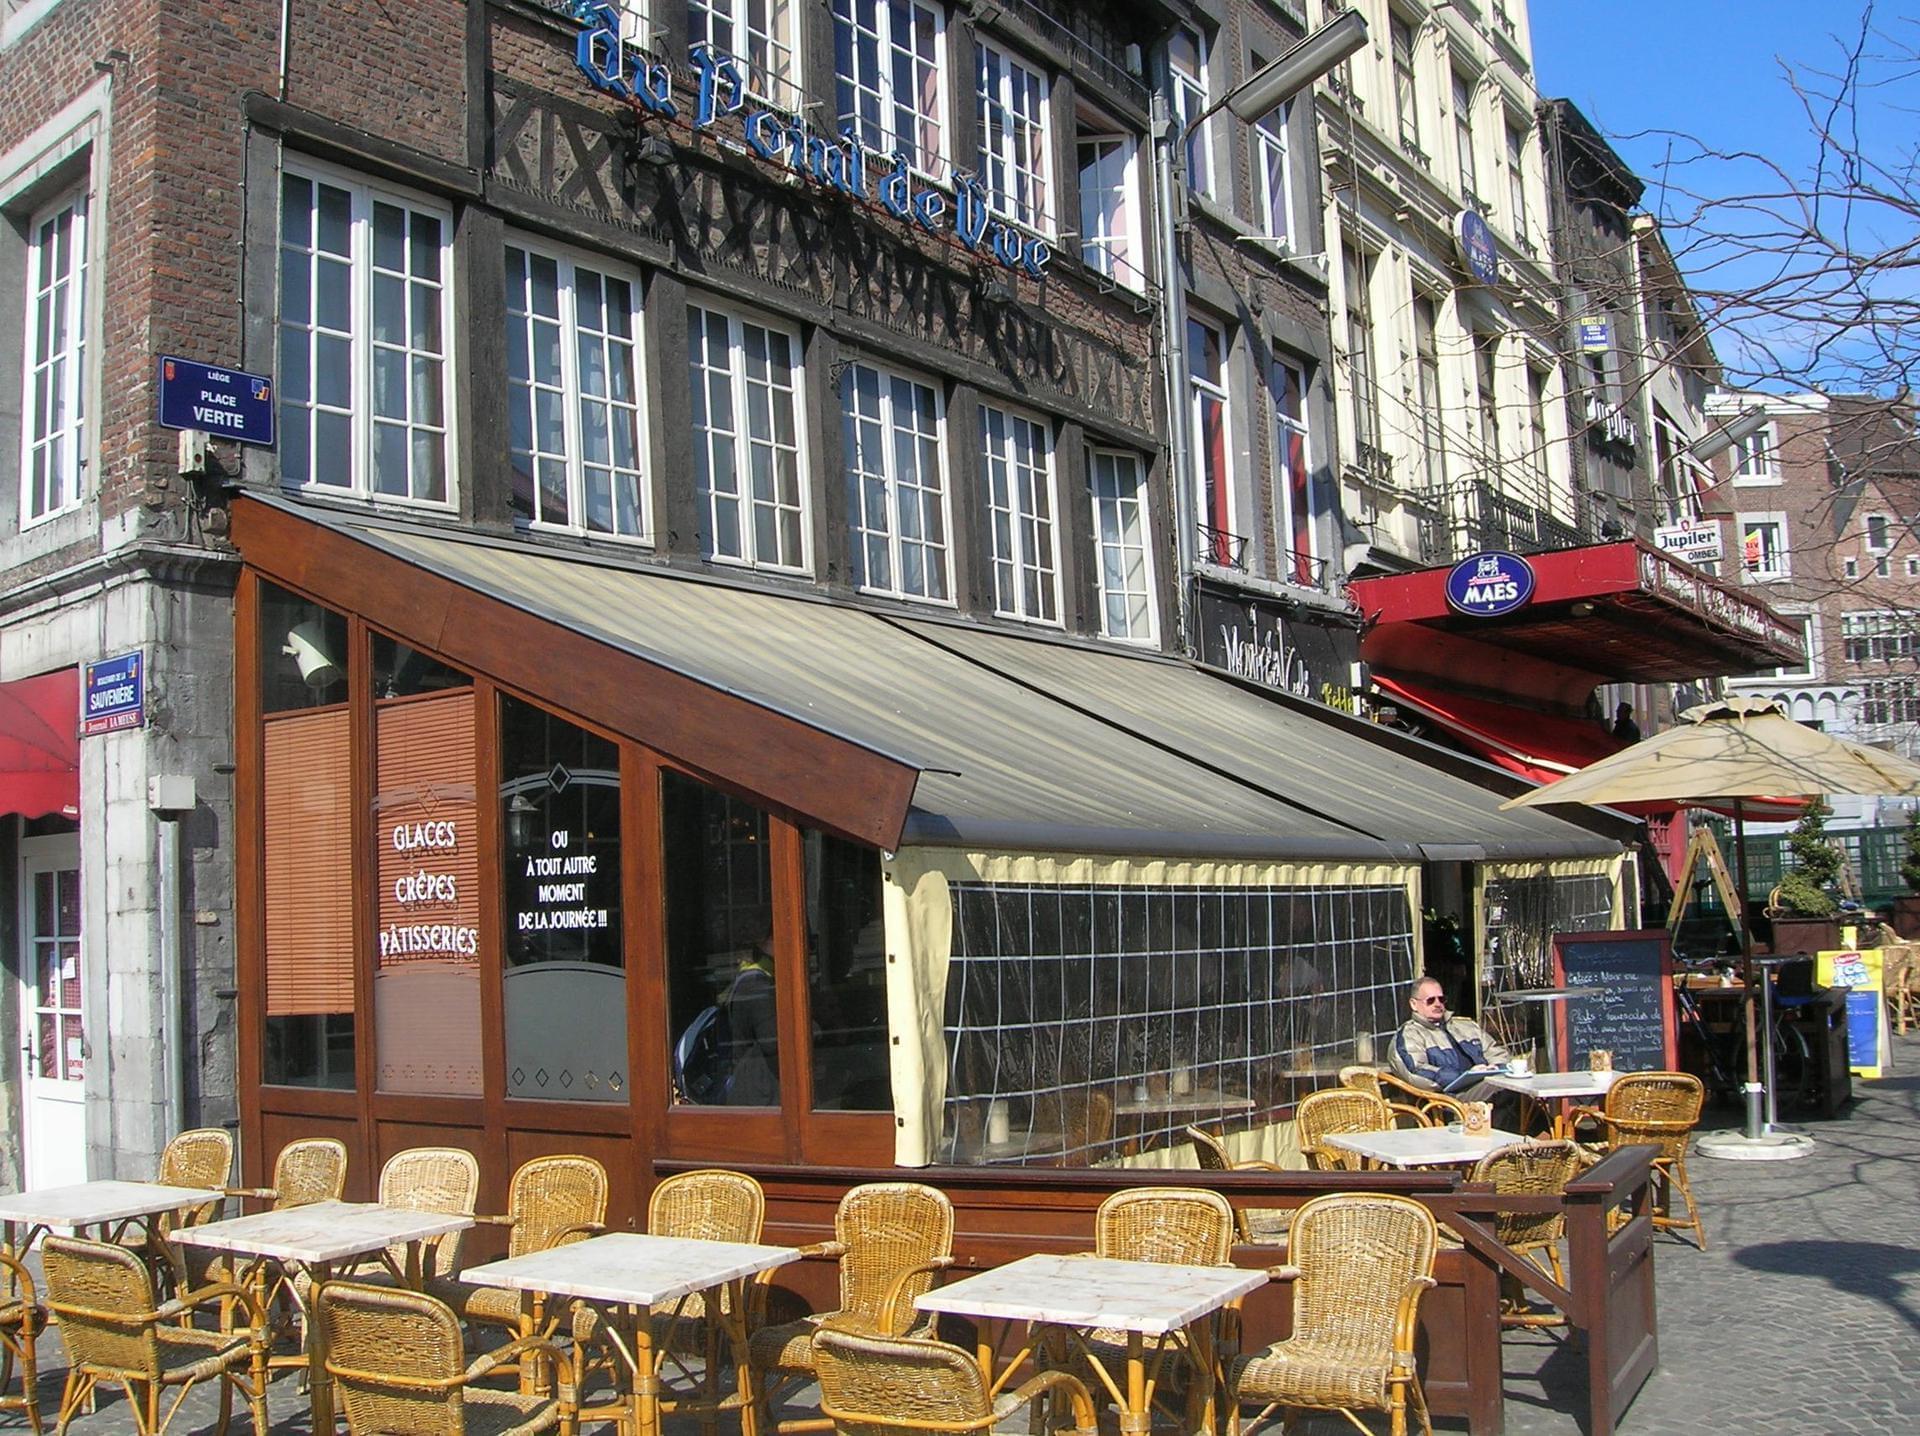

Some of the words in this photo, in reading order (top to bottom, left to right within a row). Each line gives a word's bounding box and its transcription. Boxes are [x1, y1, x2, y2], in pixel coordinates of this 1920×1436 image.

[692, 48, 870, 200] Point
[879, 151, 945, 233] de
[207, 371, 231, 383] LIÈGE
[201, 390, 237, 407] PLACE
[193, 405, 244, 429] VERTE
[1660, 531, 1716, 549] Jupiler
[1462, 582, 1518, 604] MAES
[90, 683, 135, 711] SAUVENIÈRE
[393, 821, 456, 850] GLACES
[552, 830, 569, 849] OU
[526, 855, 535, 877] À
[535, 857, 563, 876] TOUT
[563, 855, 597, 875] AUTRE
[395, 868, 456, 902] CRÊPES
[538, 883, 585, 903] MOMENT
[518, 911, 534, 930] DE
[534, 911, 549, 929] LA
[549, 907, 597, 929] JOURNÉE
[380, 924, 478, 956] PÂTISSERIES
